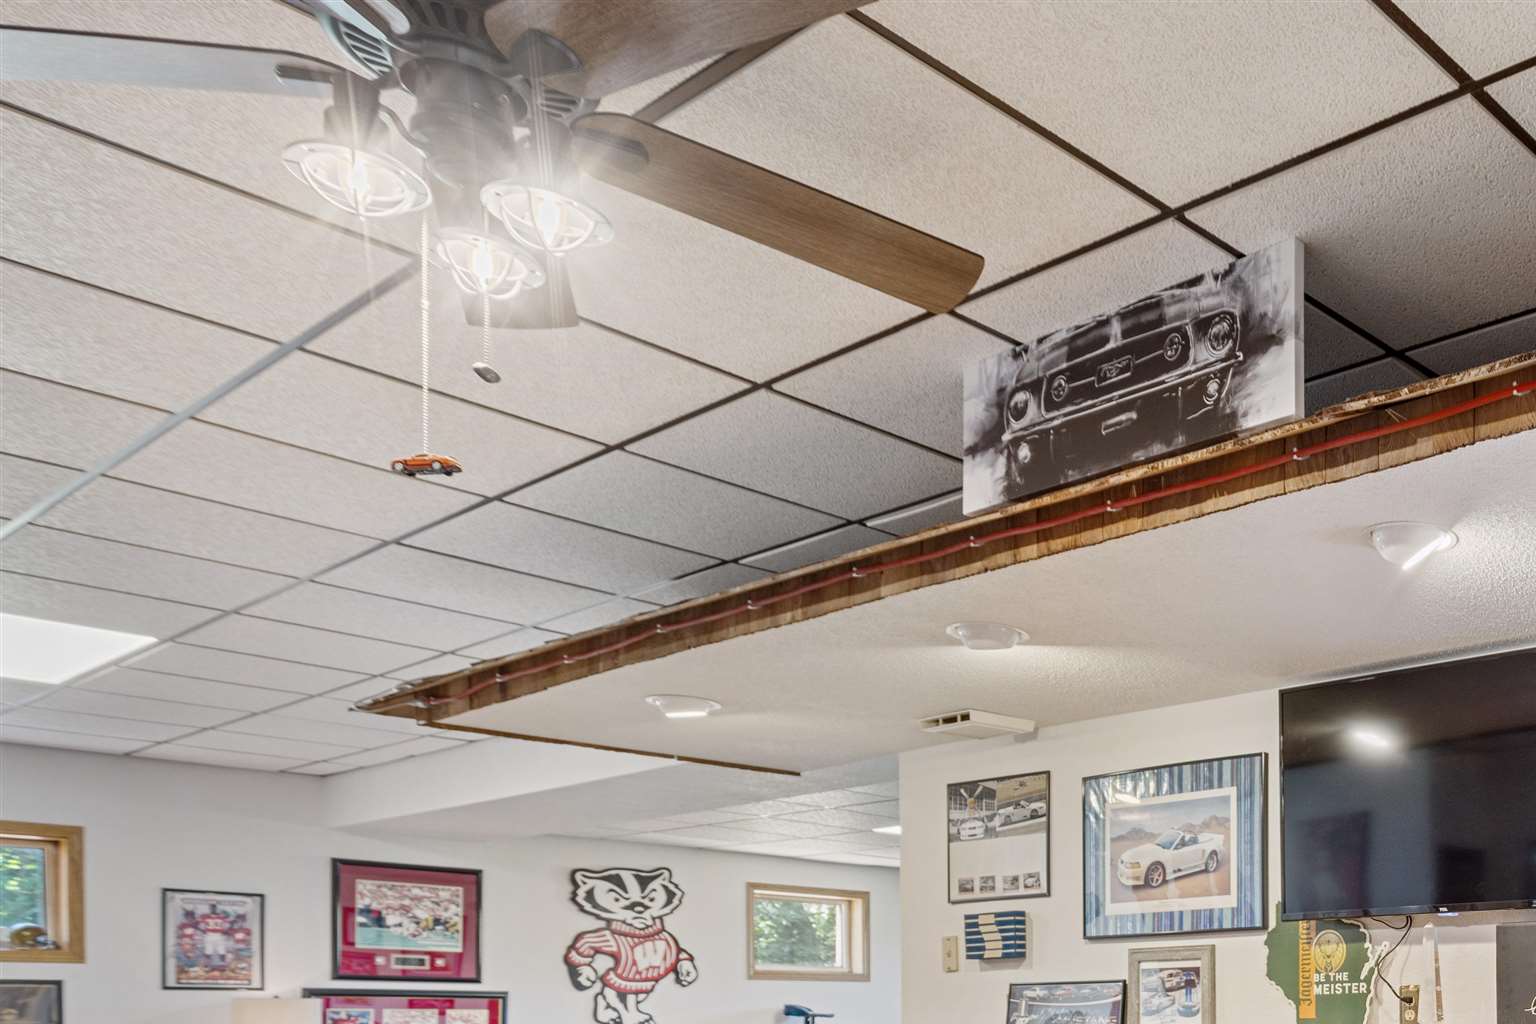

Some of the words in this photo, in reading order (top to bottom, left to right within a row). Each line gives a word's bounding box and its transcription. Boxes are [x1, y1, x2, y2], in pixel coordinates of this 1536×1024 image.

[1313, 973, 1326, 983] BE
[1328, 972, 1350, 982] THE
[1313, 983, 1367, 996] MEISTER
